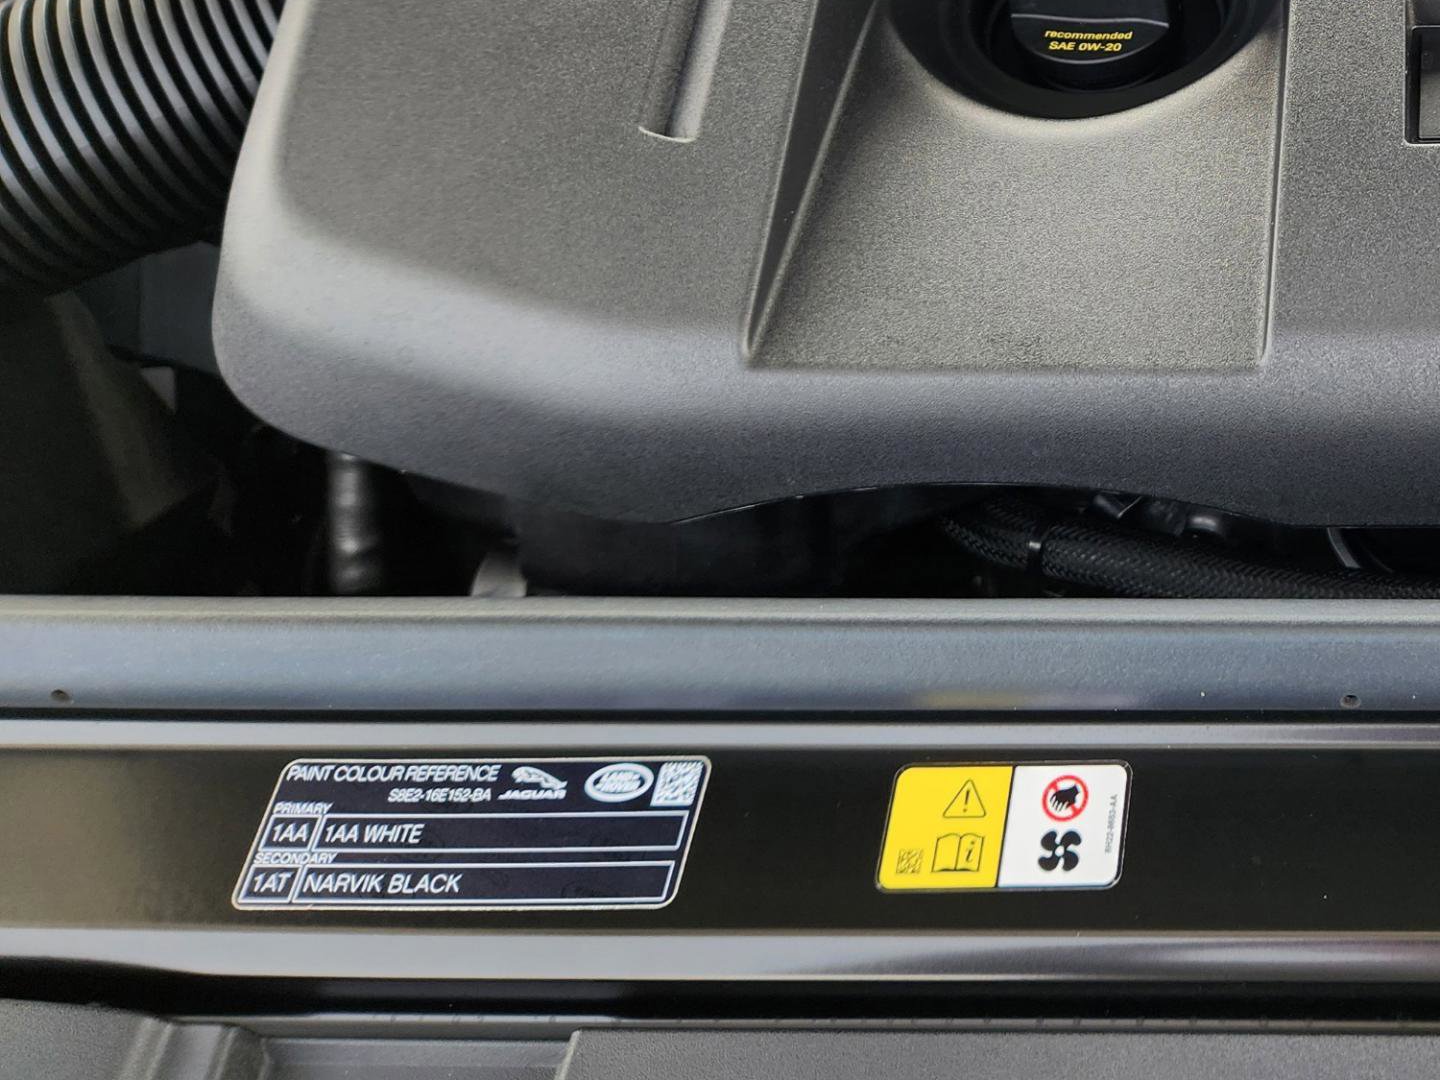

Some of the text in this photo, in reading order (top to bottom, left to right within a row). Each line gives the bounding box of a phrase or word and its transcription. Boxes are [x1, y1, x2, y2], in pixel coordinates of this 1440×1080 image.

[1045, 30, 1133, 40] recommended
[1049, 41, 1122, 52] SAE 0W-20
[287, 765, 501, 782] PAINT COLOUR REFERENCE
[498, 789, 567, 800] JAGUAR
[272, 802, 333, 814] PRIMARY
[273, 823, 425, 843] 1AA 1AA WHITE
[253, 852, 339, 864] SECONDARY
[253, 872, 463, 894] 1AT NARVIK BLACK
